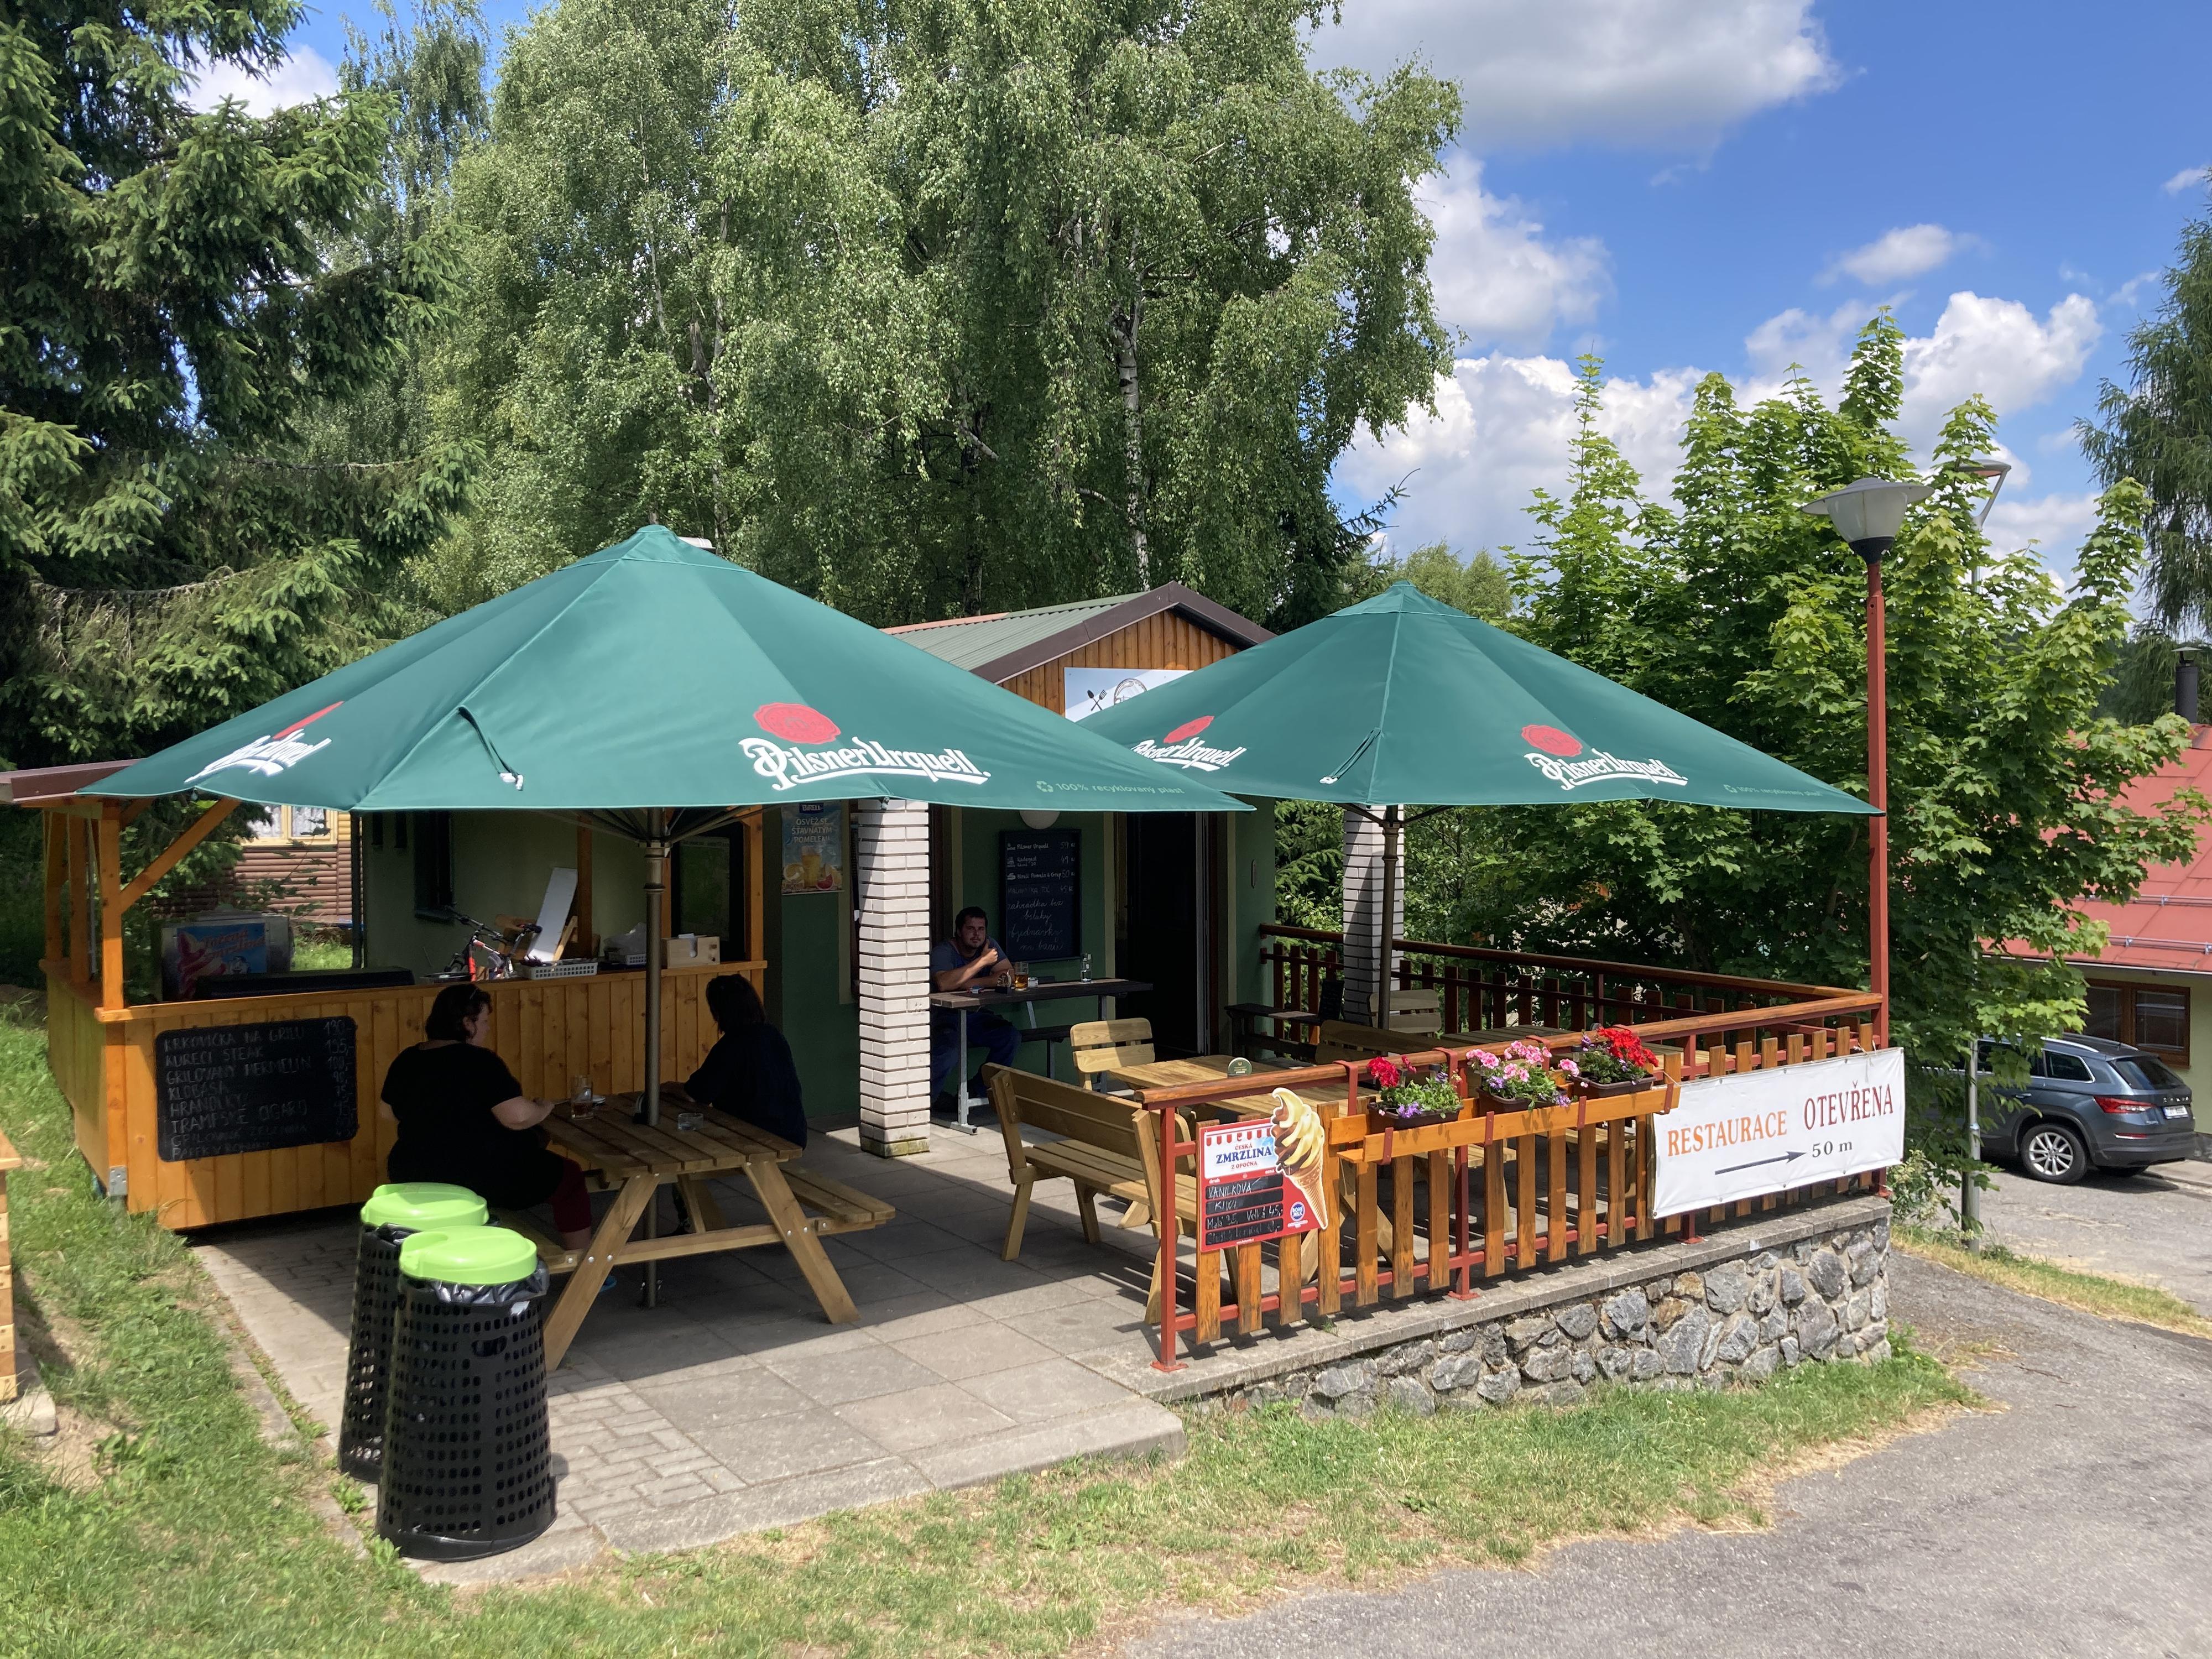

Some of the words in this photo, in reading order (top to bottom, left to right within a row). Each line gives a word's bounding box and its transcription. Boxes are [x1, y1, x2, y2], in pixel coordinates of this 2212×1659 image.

[738, 737, 872, 791] Pilsner
[1524, 753, 1613, 790] Pilsner
[1092, 784, 1156, 794] recyklovaný
[1803, 1081, 1893, 1130] OTEVŘENA
[1667, 1110, 1787, 1156] RESTAURACE
[1215, 1146, 1272, 1164] ZMRZLINA
[1235, 1142, 1253, 1150] ČESKÁ
[1812, 1141, 1833, 1158] 50
[1839, 1140, 1853, 1153] m
[1214, 1199, 1237, 1212] KIWI
